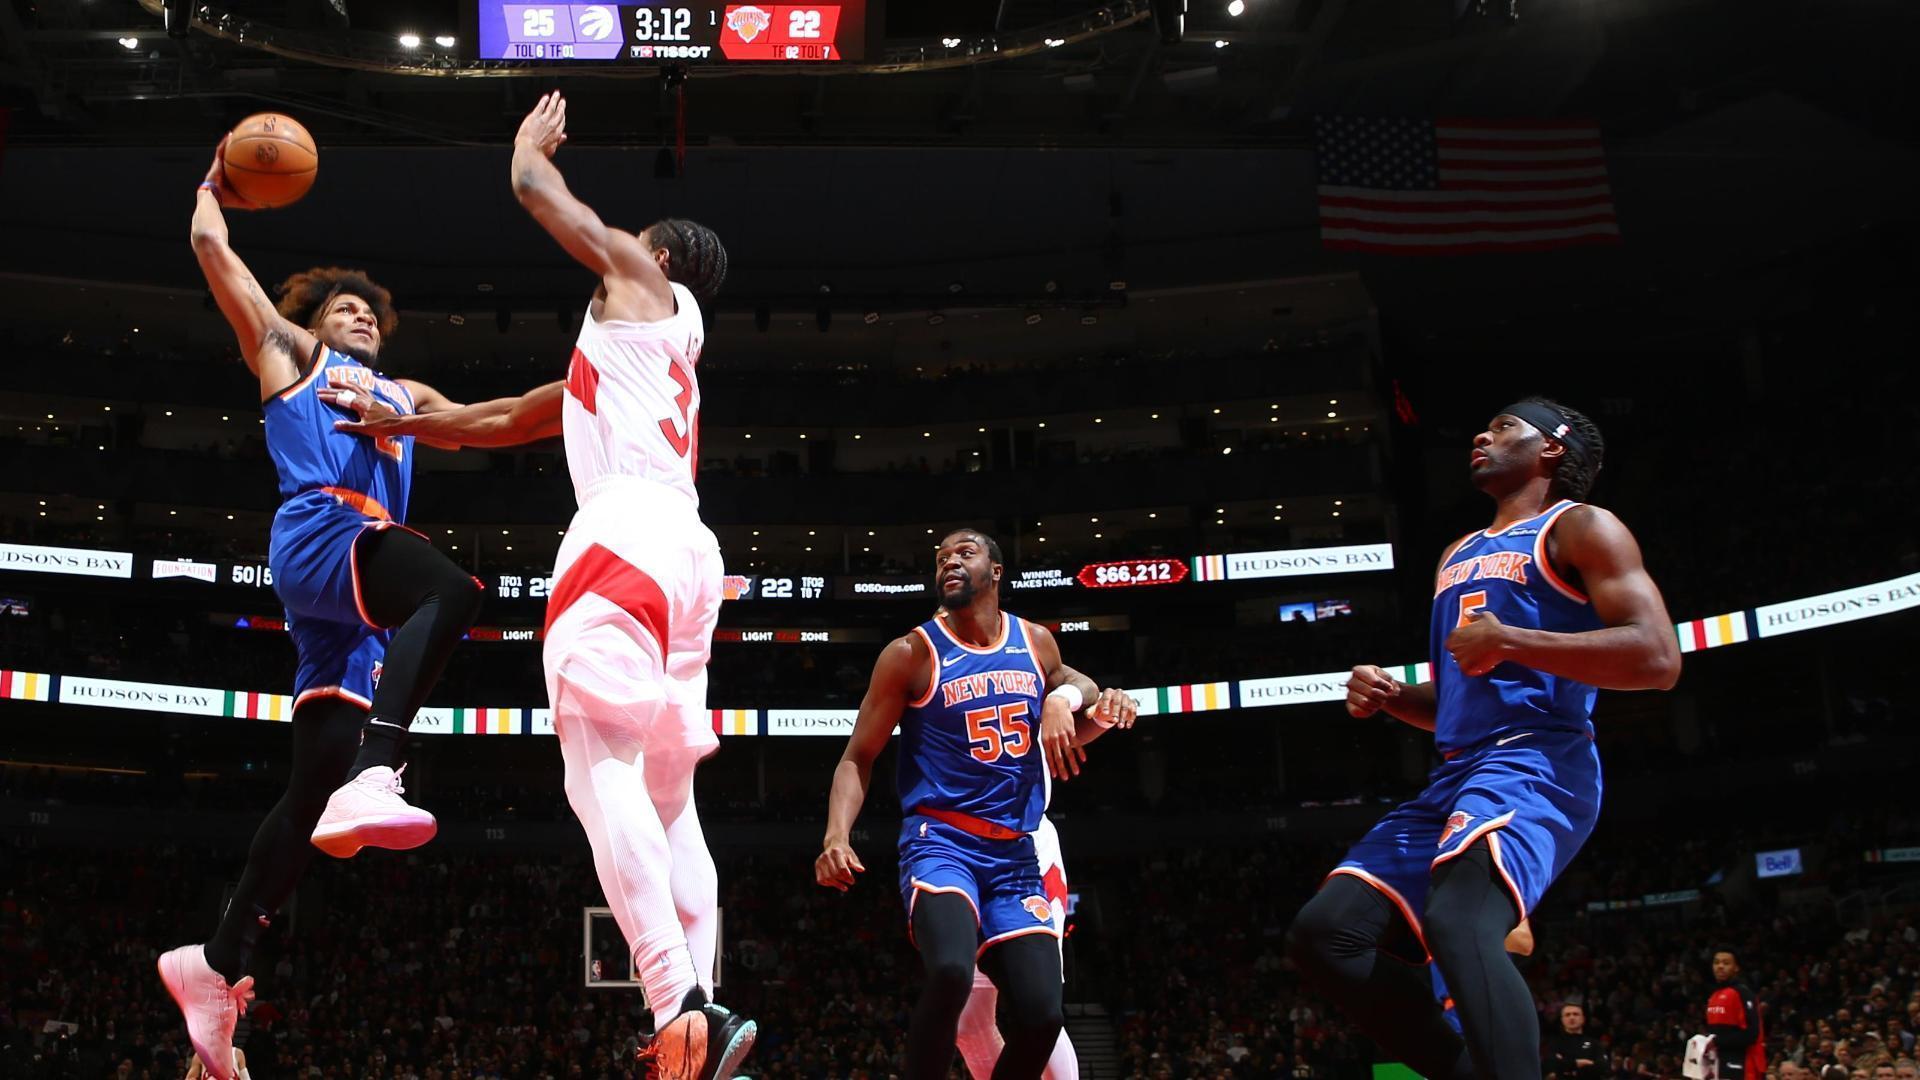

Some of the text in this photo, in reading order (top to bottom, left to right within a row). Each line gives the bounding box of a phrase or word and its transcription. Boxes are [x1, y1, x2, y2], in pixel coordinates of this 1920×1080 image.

[523, 9, 554, 36] 25
[635, 8, 691, 41] 3:12
[710, 10, 716, 26] 1
[789, 10, 820, 38] 22
[515, 45, 533, 57] TOL
[536, 45, 544, 58] 6
[550, 45, 562, 57] TF
[653, 47, 711, 59] TISSOT
[772, 45, 830, 59] TF 02 TOL 7
[658, 360, 698, 480] 3
[86, 556, 125, 570] BAY
[1235, 551, 1386, 571] HUDSON'S BAY
[1471, 551, 1532, 586] YORK
[157, 563, 213, 578] FOUNDATION
[1021, 570, 1061, 580] WINNER
[1096, 563, 1171, 585] $66,212
[762, 579, 793, 598] 22
[854, 583, 925, 593] 5050raps.com
[1011, 577, 1073, 589] TAKES HOME
[1768, 594, 1880, 626] HUDSON'S
[1060, 621, 1089, 632] ZONE
[502, 630, 534, 640] LIGHT
[742, 632, 773, 641] LIGHT
[801, 632, 829, 641] ZONE
[73, 685, 211, 707] HUDSON'S BAY
[941, 670, 1038, 708] NEW YORK
[965, 701, 1031, 763] 55
[1766, 856, 1791, 870] Bell
